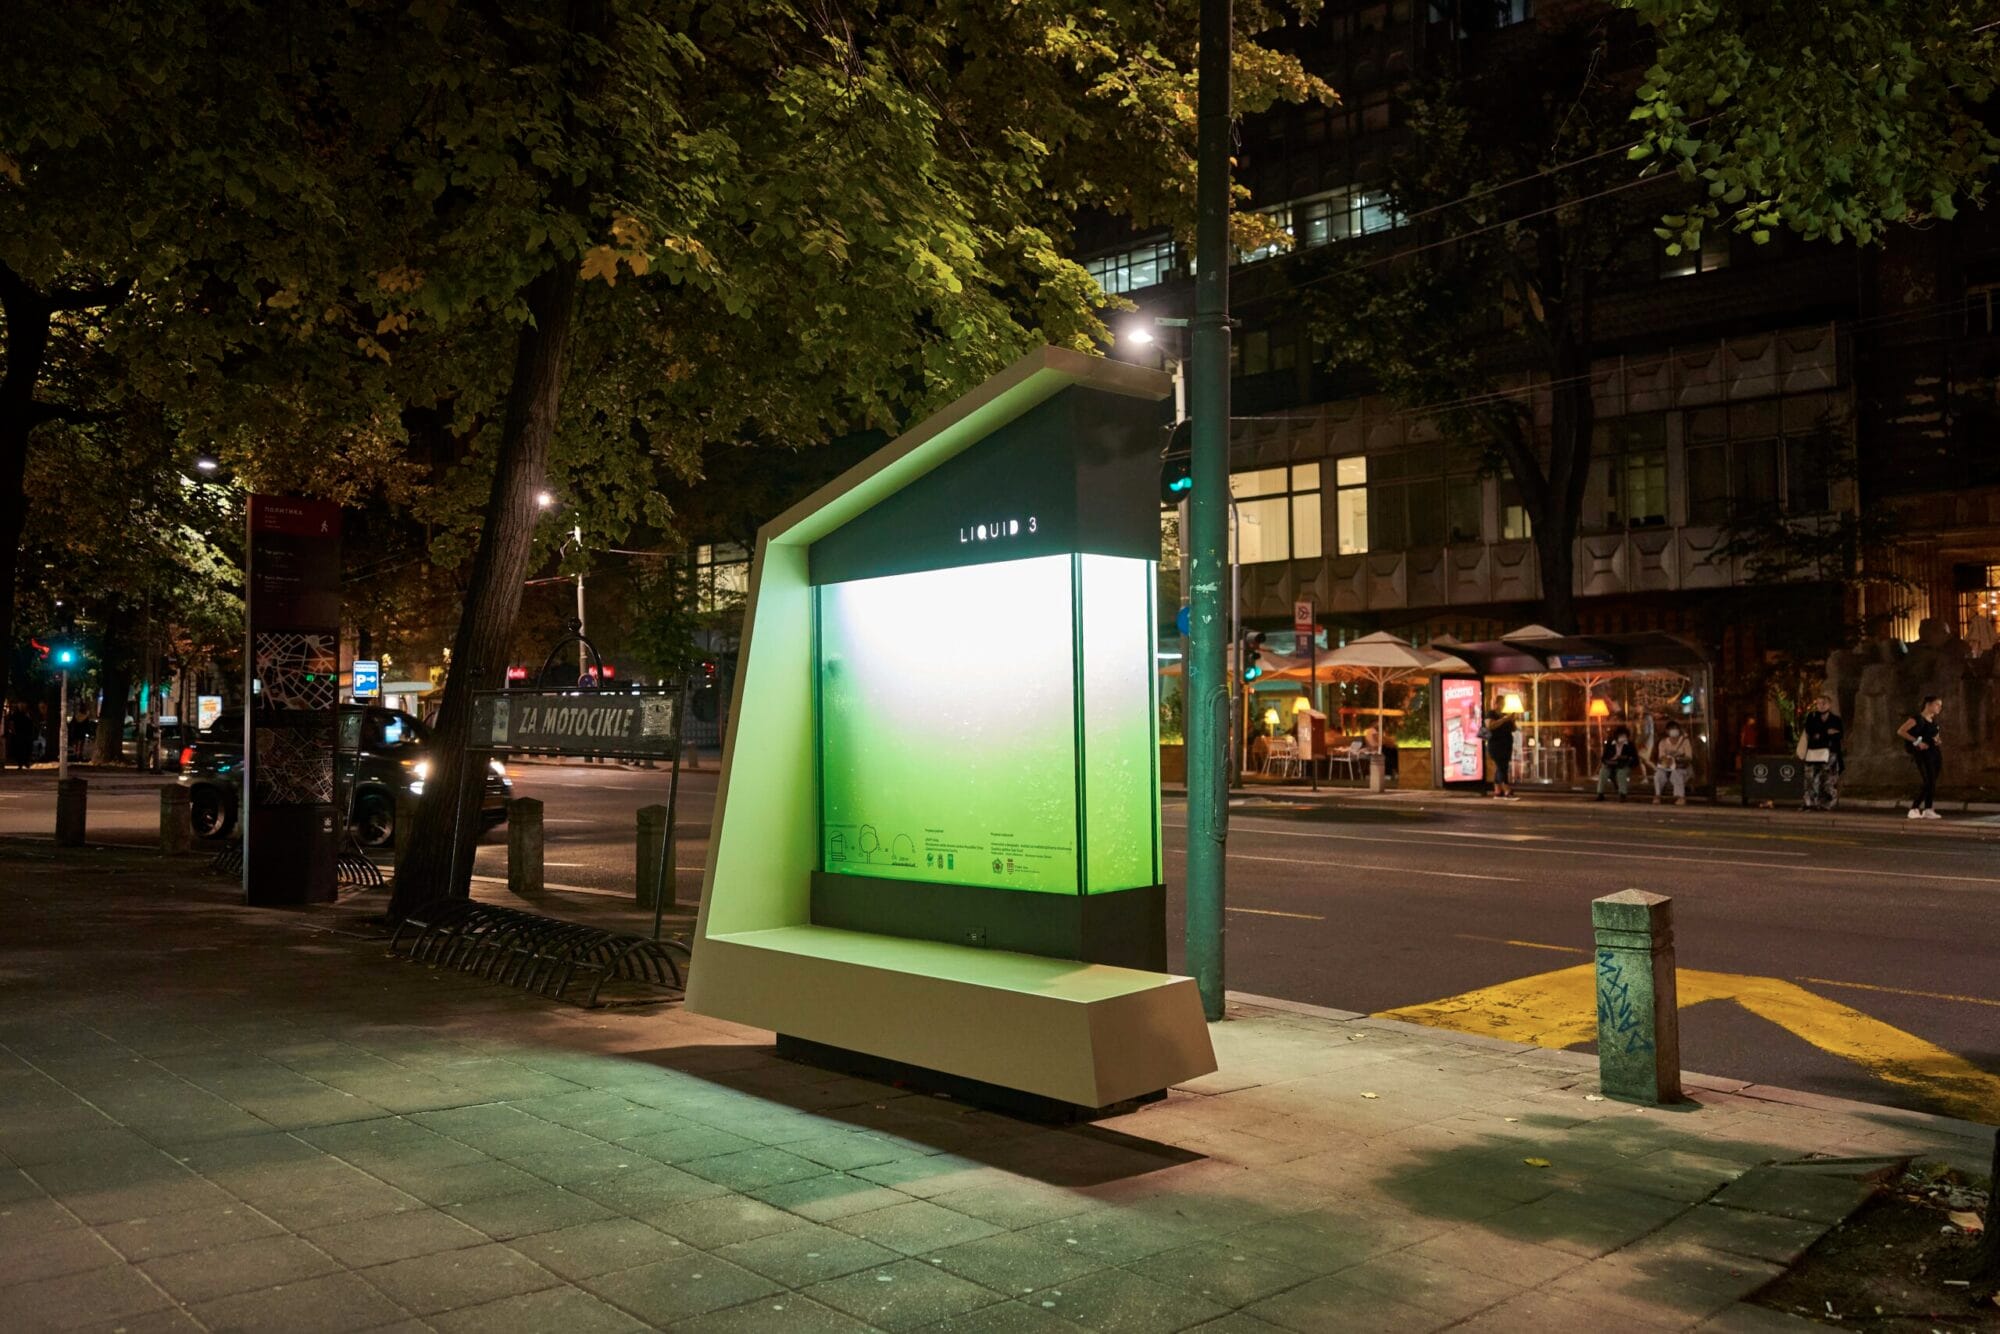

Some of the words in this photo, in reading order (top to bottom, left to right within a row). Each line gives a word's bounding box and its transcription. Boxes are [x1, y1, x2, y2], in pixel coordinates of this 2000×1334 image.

[960, 519, 1019, 543] LIQUID
[1028, 516, 1037, 533] 3
[356, 674, 367, 687] P
[518, 707, 538, 735] ZA
[541, 707, 635, 738] MOTOCIKLE
